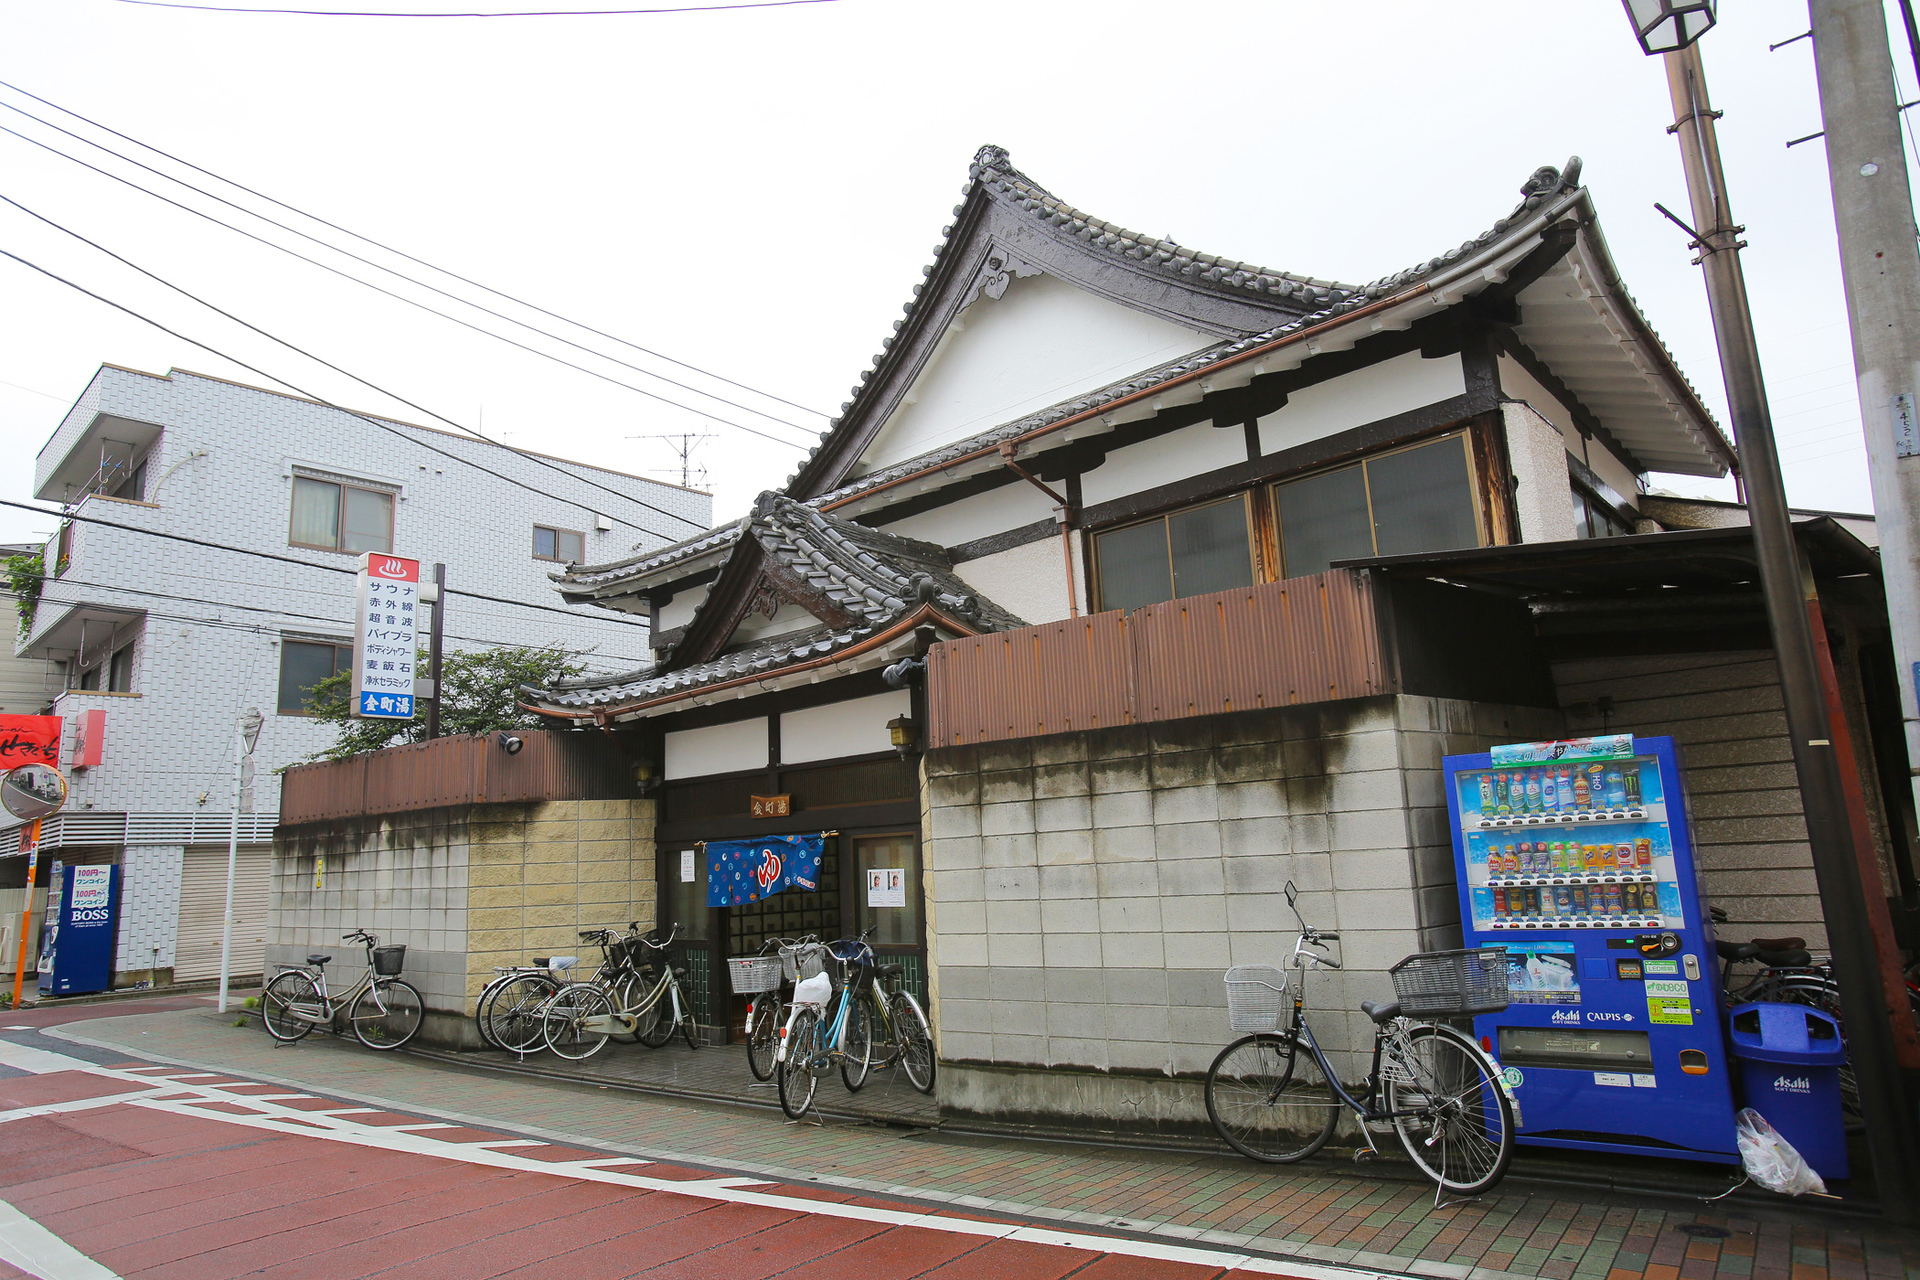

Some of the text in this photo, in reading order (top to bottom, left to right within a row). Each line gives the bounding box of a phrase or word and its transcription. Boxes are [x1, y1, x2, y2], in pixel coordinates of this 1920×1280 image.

[370, 582, 414, 596] サウナ
[369, 597, 414, 612] 赤外線
[368, 612, 413, 627] 超音波
[366, 643, 412, 657] ボディシャワー
[366, 659, 411, 673] 麦飯石
[364, 675, 411, 689] 浄水セラミック
[363, 693, 411, 714] 金町湯
[753, 800, 788, 816] 金町湯
[757, 848, 782, 894] ゆ
[71, 909, 109, 922] BOSS
[1551, 1010, 1621, 1022] Asahi CALPIS
[1773, 1076, 1810, 1088] Asahi
